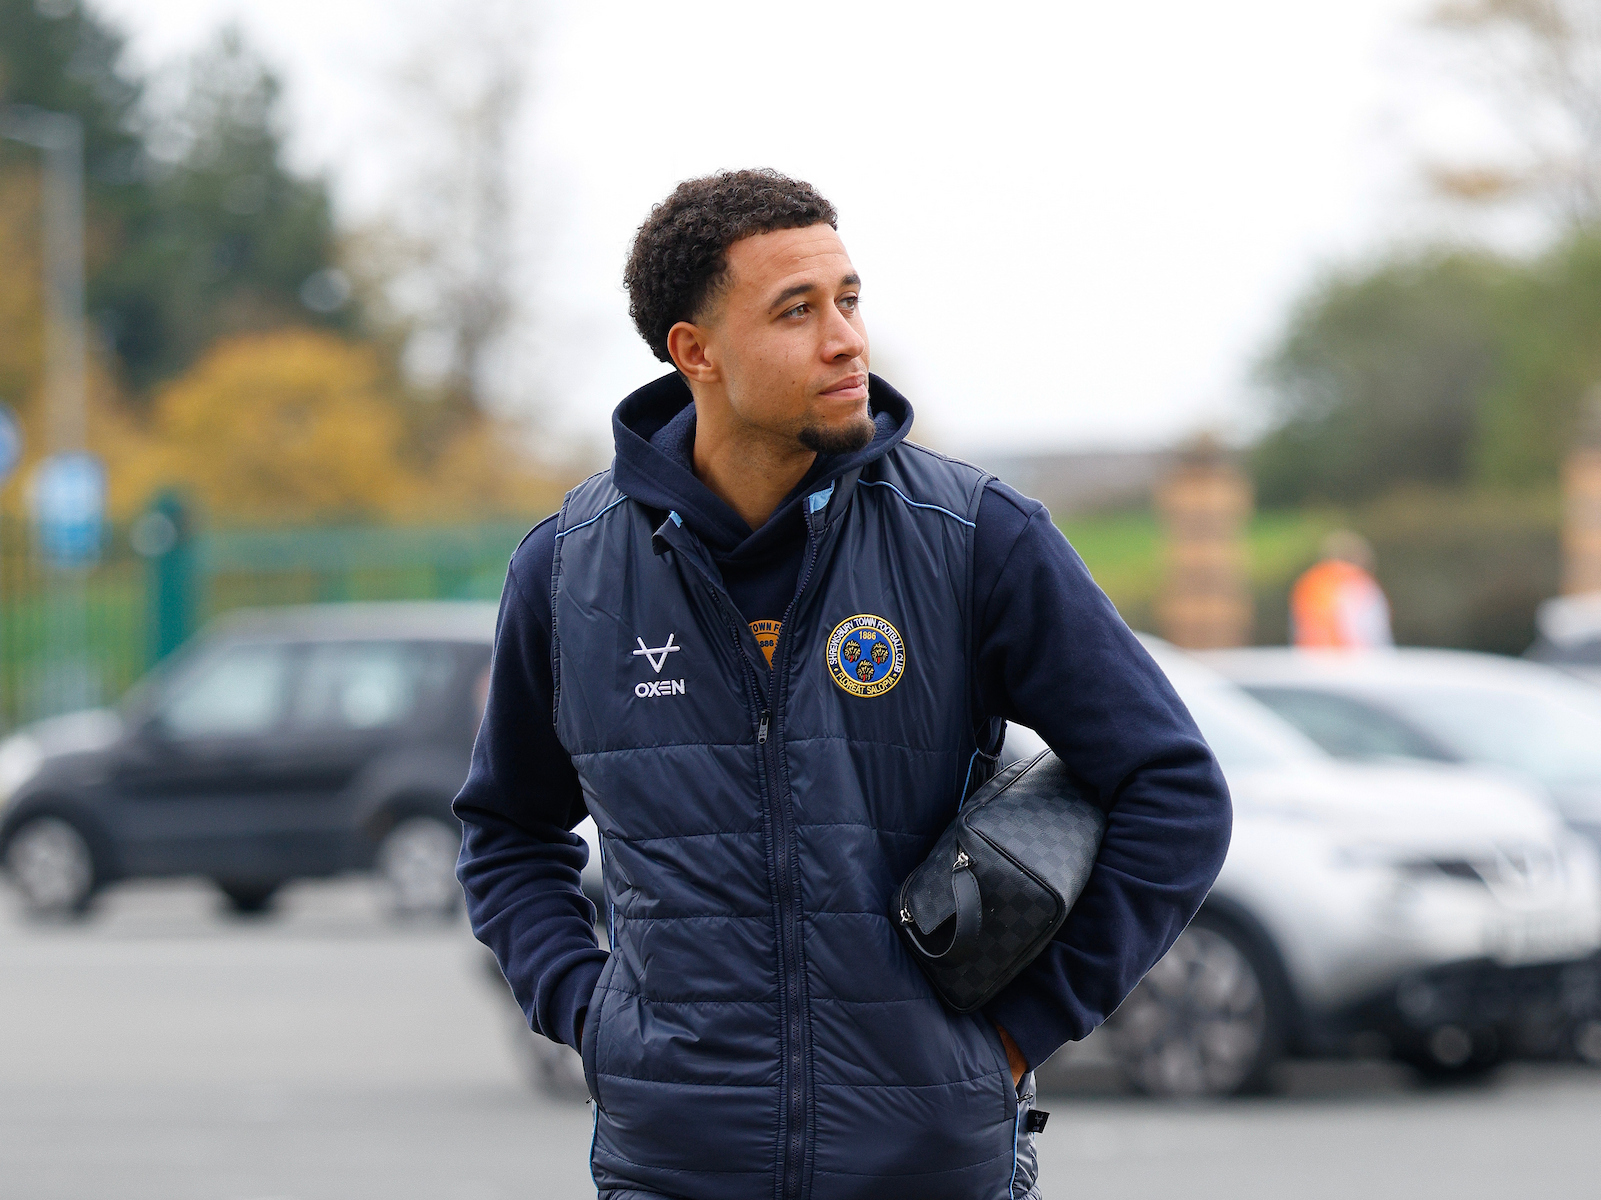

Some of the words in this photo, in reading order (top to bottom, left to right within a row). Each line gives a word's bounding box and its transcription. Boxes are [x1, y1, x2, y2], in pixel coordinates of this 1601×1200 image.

[829, 620, 854, 665] SHREWSBURY
[853, 617, 877, 627] TOWN
[877, 620, 904, 654] FOOTBALL
[893, 653, 904, 673] CLUB
[859, 631, 876, 640] 1886
[635, 678, 686, 698] OXEN
[836, 672, 865, 694] FLOREAT
[866, 676, 895, 695] SALOPIA
